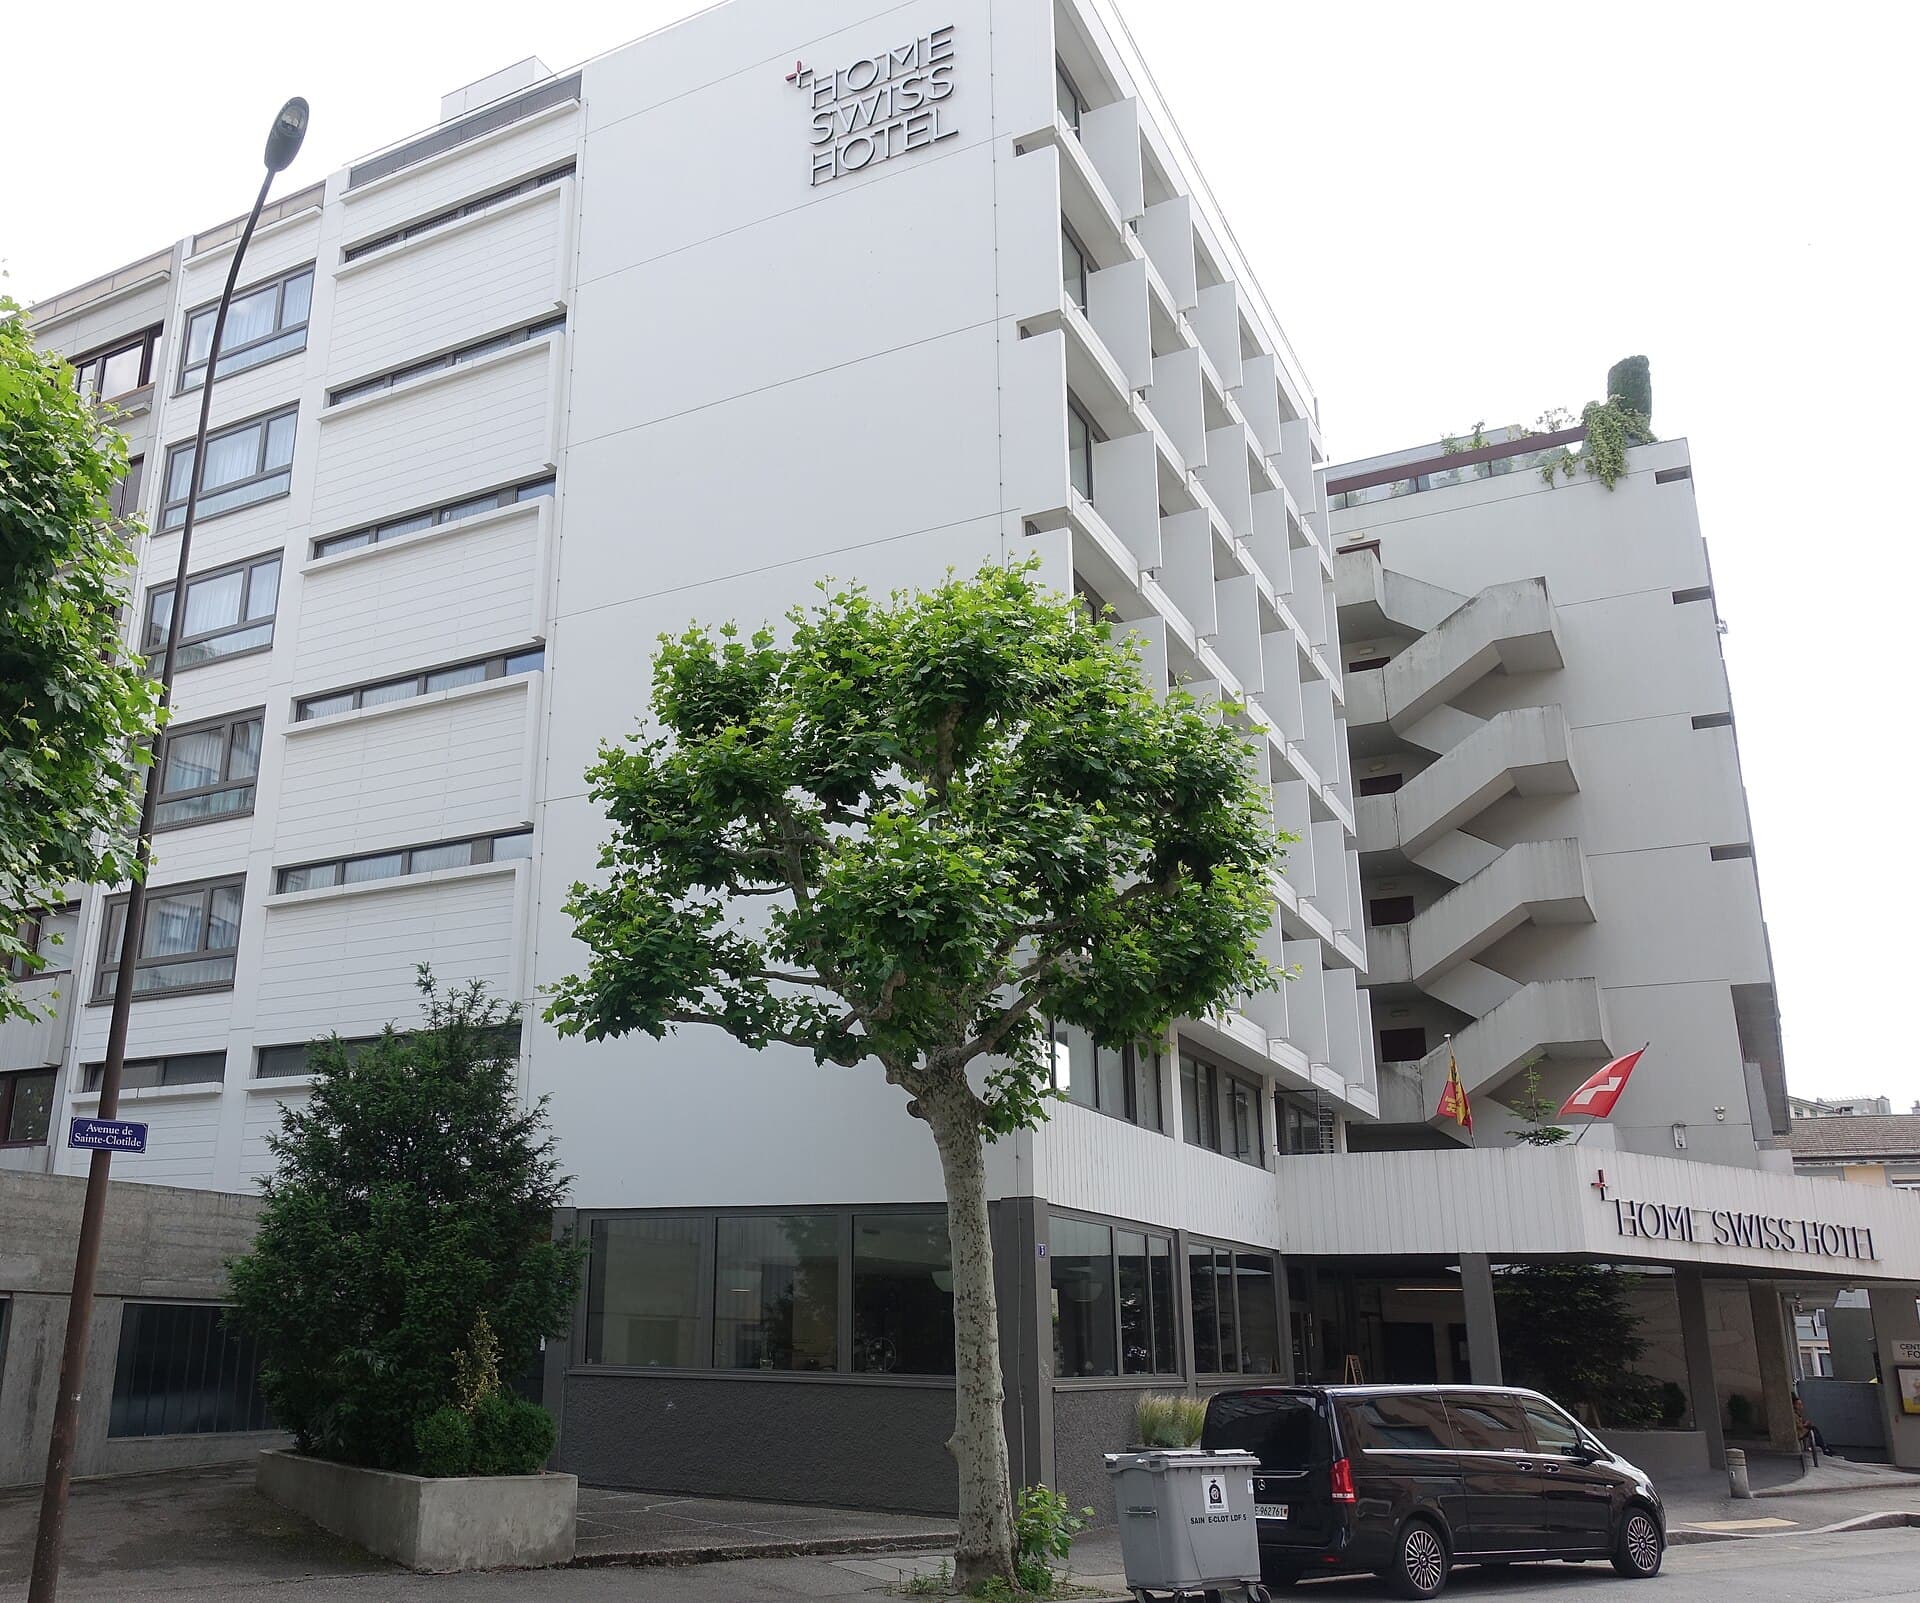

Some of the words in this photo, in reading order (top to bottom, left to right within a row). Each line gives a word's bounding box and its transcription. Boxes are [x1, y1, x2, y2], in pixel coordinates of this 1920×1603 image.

[811, 24, 955, 110] HOME
[809, 65, 955, 145] SWISS
[810, 107, 960, 187] HOTEL
[74, 1132, 142, 1147] Sainte-Clotilde
[86, 1123, 120, 1135] Avenue
[122, 1125, 134, 1136] de
[1615, 1198, 1700, 1242] HOME
[1711, 1209, 1795, 1251] SWISS
